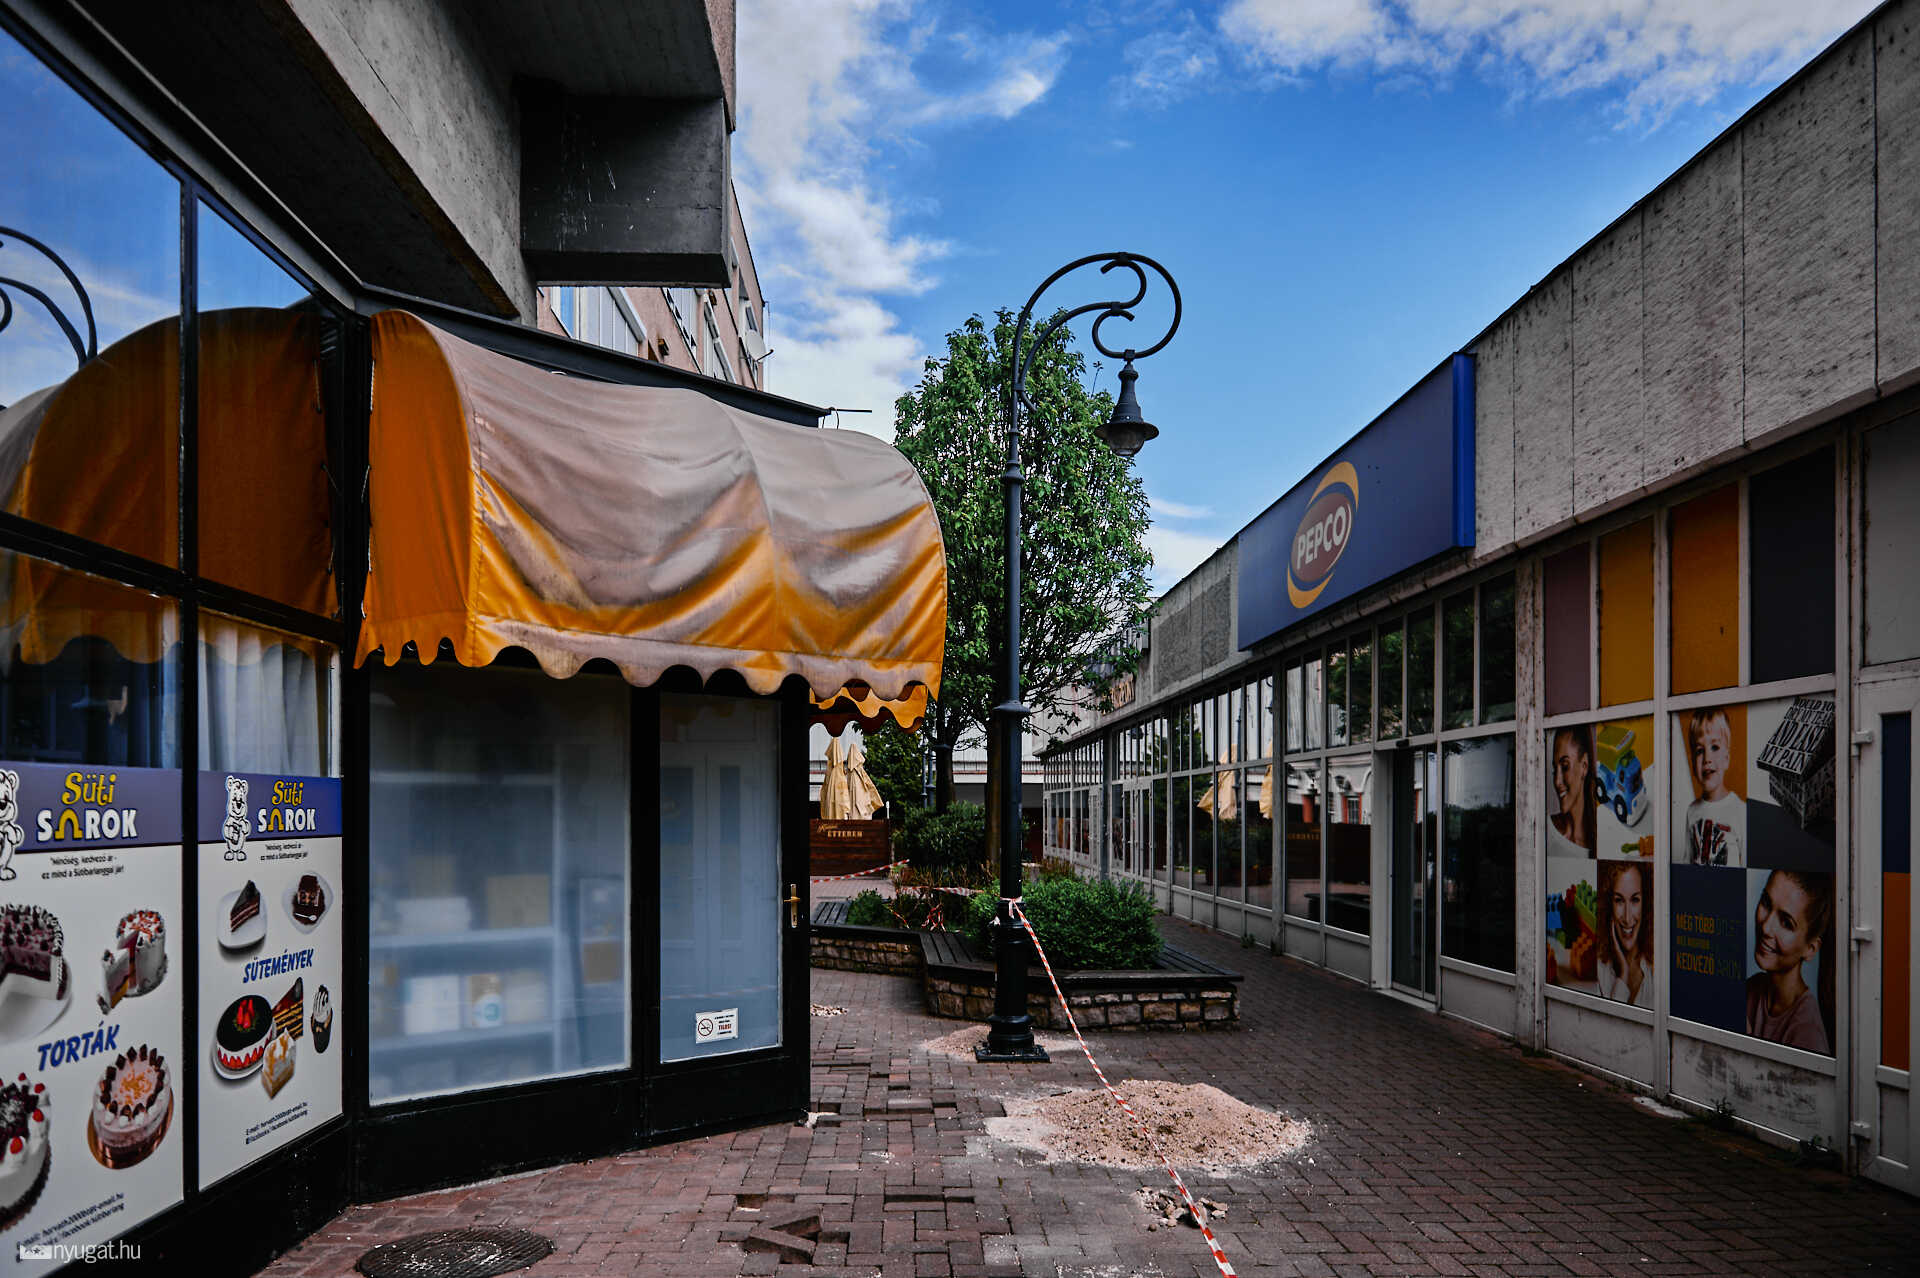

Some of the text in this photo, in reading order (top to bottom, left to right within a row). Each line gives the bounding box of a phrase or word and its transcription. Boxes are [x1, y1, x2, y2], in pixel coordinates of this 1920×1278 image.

[1296, 504, 1347, 570] PEPCO
[1768, 720, 1829, 754] AND EASE
[1759, 740, 1806, 772] MY PAIN
[61, 771, 116, 806] Süti
[271, 780, 305, 805] Süti
[37, 808, 138, 843] SAROK
[257, 807, 317, 833] SAROK
[1694, 915, 1715, 934] TÖBB
[243, 948, 314, 984] SÜTEMÉNYEK
[38, 1021, 120, 1071] TORTÁK
